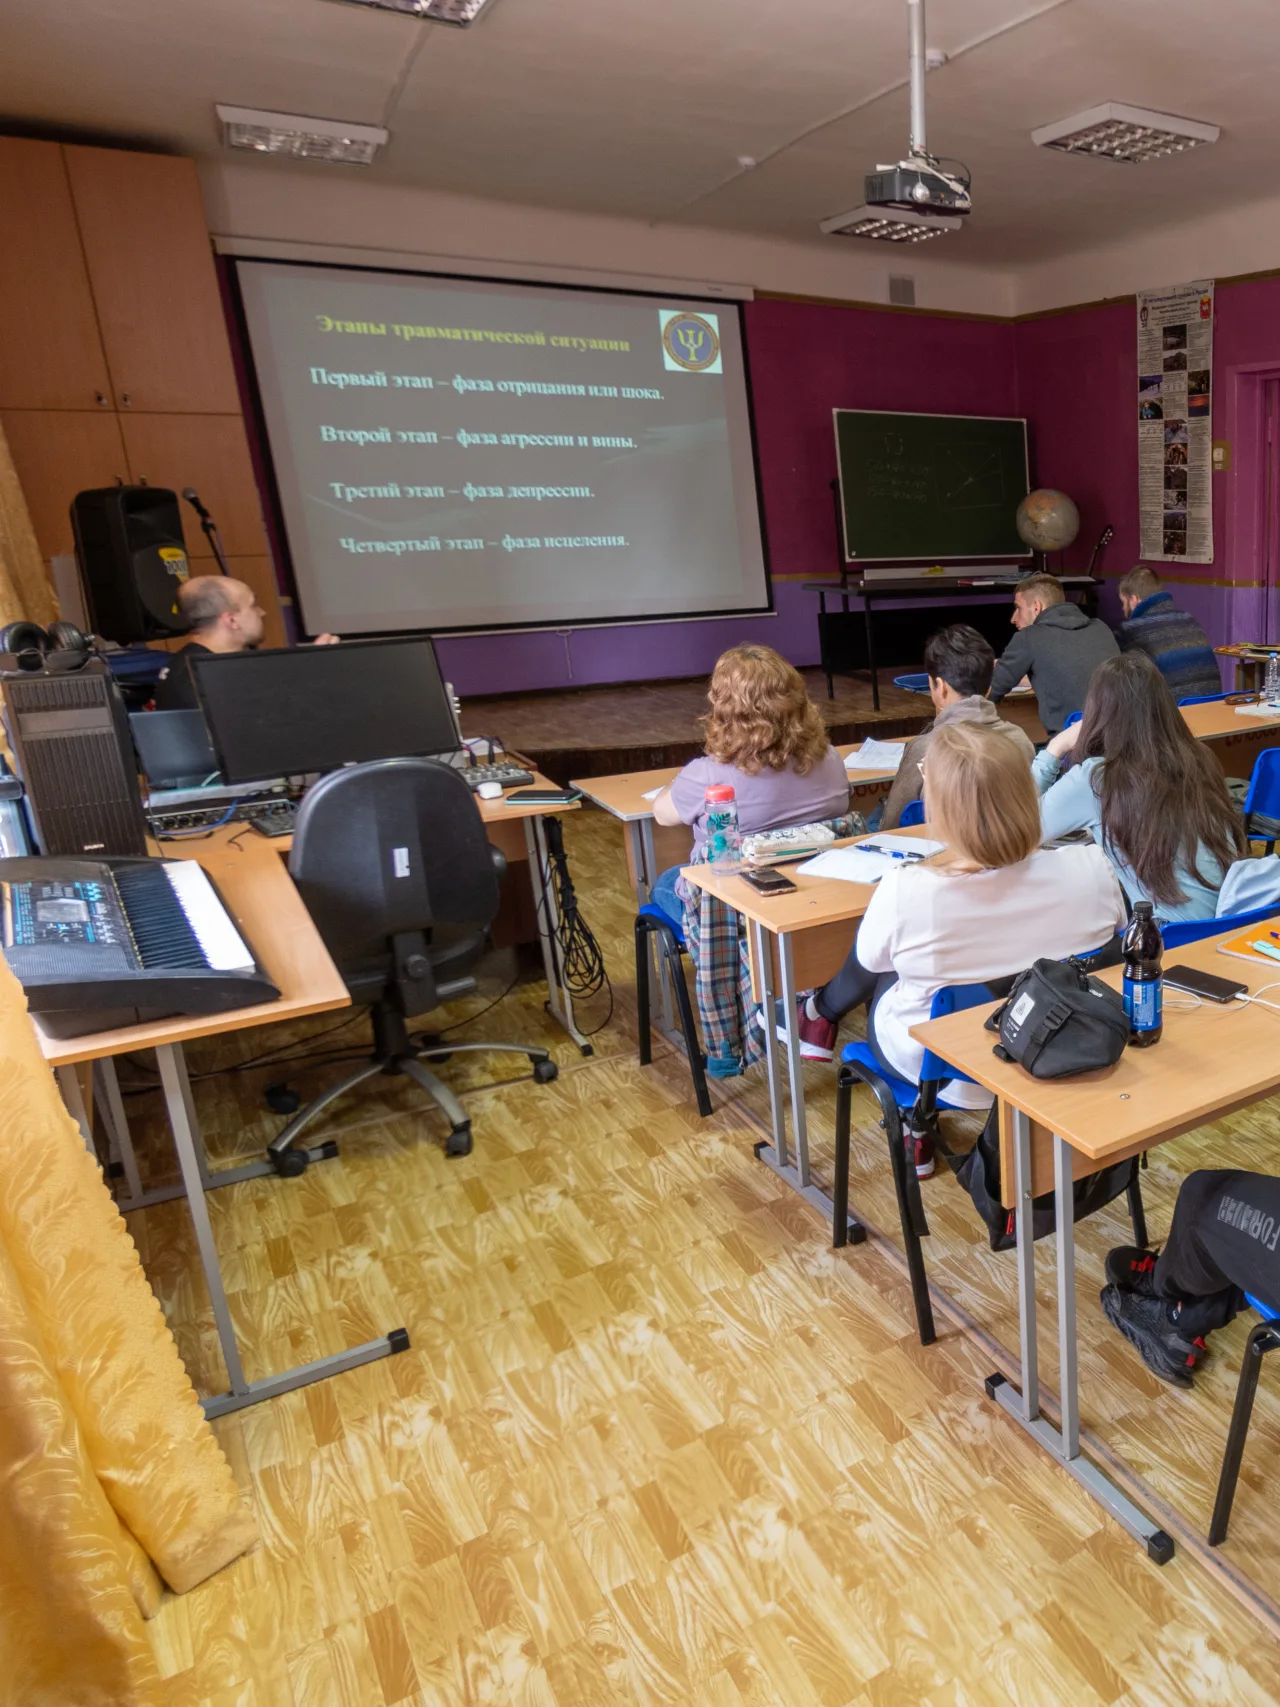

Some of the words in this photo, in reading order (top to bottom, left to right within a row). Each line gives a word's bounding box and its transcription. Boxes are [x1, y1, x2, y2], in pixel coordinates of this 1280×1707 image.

[315, 314, 386, 335] Этапы
[391, 324, 546, 346] травматической
[550, 335, 630, 351] ситуации
[309, 367, 388, 389] Первый
[391, 375, 434, 389] этап
[452, 374, 494, 394] фаза
[496, 380, 585, 396] отрицания
[588, 386, 618, 398] или
[621, 386, 664, 400] шока.
[320, 425, 392, 446] Второй
[395, 430, 438, 444] этап
[456, 428, 498, 448] фаза
[501, 433, 574, 449] агрессии
[577, 435, 589, 447] и
[592, 435, 638, 448] вины.
[329, 482, 401, 502] Третий
[404, 485, 445, 498] этап
[463, 482, 504, 502] фаза
[507, 485, 595, 501] депрессии.
[339, 536, 441, 556] Четвертый
[444, 538, 484, 551] этап
[502, 534, 541, 552] фаза
[544, 535, 630, 549] исцеления.
